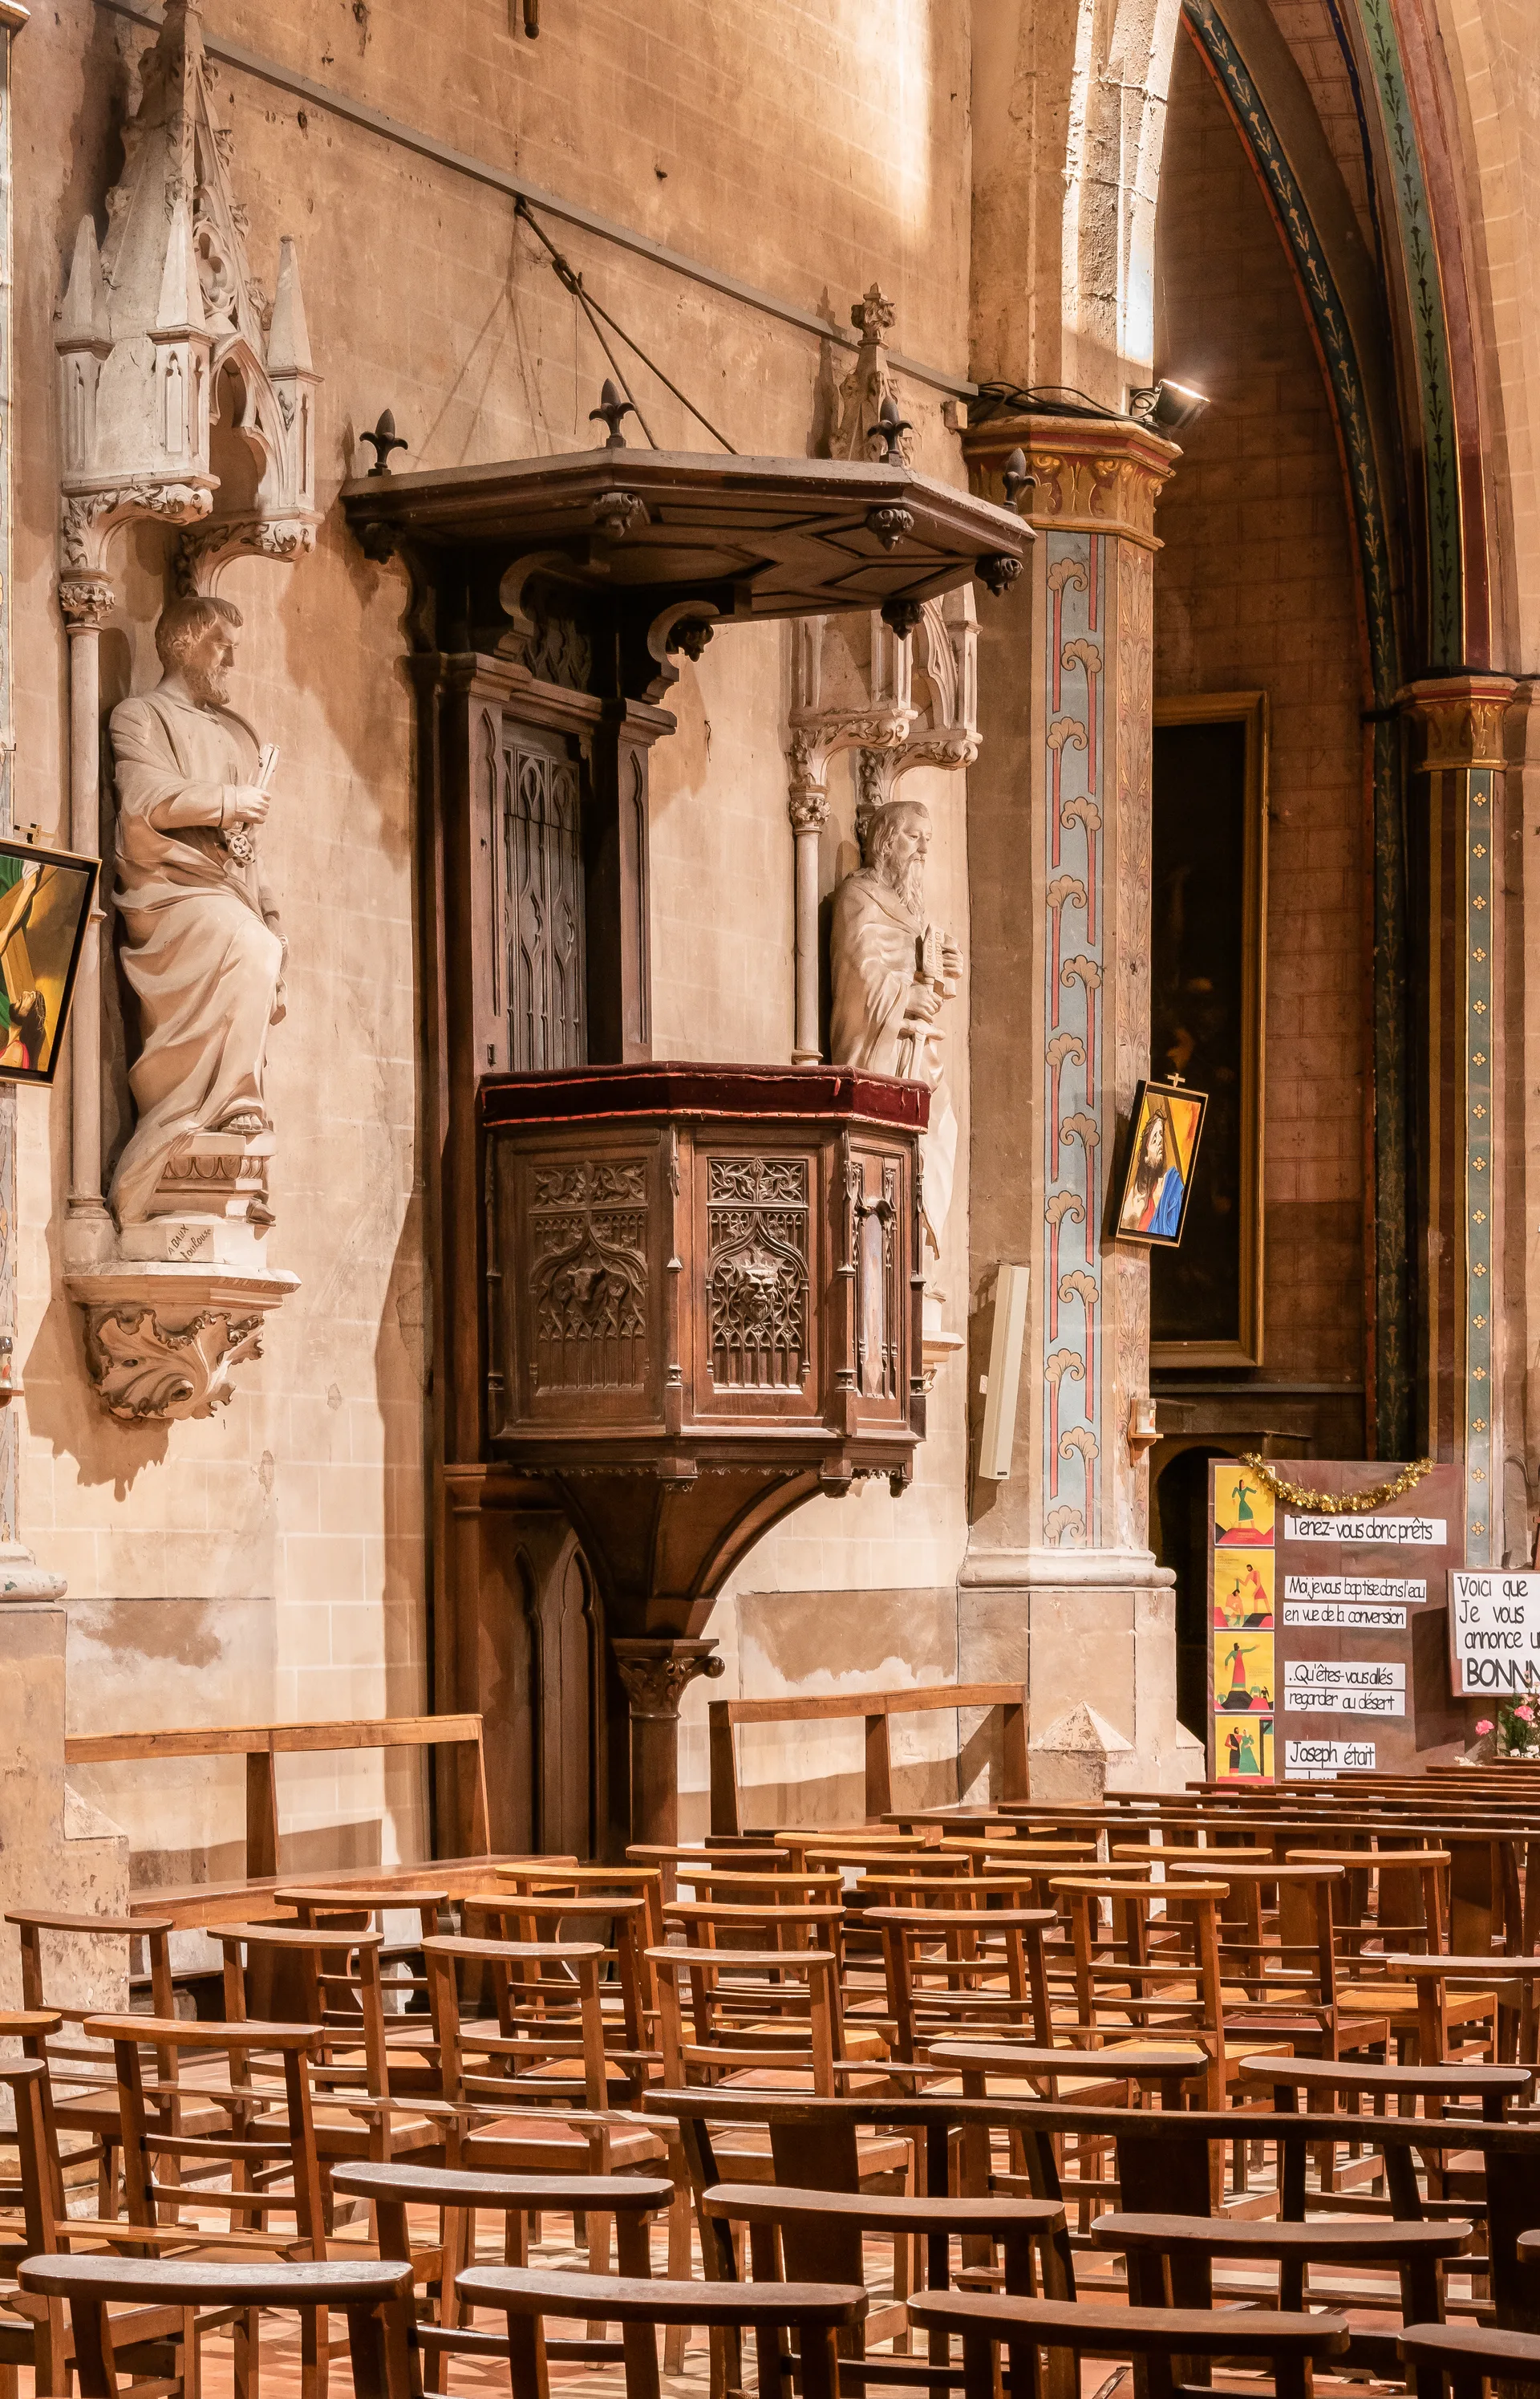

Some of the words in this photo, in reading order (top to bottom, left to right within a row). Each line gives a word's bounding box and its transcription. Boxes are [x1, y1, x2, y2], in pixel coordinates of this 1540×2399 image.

[1290, 1514, 1364, 1539] Tenez-vous
[1366, 1517, 1397, 1539] donc
[1398, 1516, 1433, 1545] prêts
[1321, 1581, 1342, 1594] vous
[1344, 1577, 1380, 1601] baptise
[1380, 1579, 1404, 1597] dans
[1404, 1580, 1425, 1598] l'eau
[1457, 1577, 1492, 1597] Voici
[1502, 1580, 1529, 1601] que
[1285, 1609, 1299, 1622] en
[1303, 1609, 1319, 1622] vue
[1321, 1605, 1335, 1622] de
[1336, 1605, 1345, 1622] la
[1348, 1608, 1404, 1625] conversion
[1459, 1600, 1481, 1623] Je
[1493, 1605, 1525, 1624] vous
[1465, 1631, 1523, 1650] annonce
[1530, 1632, 1540, 1650] u
[1369, 1667, 1393, 1685] allés
[1290, 1689, 1338, 1710] regarder
[1342, 1697, 1356, 1710] au
[1358, 1692, 1395, 1711] désert
[1290, 1741, 1338, 1769] Joseph
[1343, 1743, 1375, 1766] était
